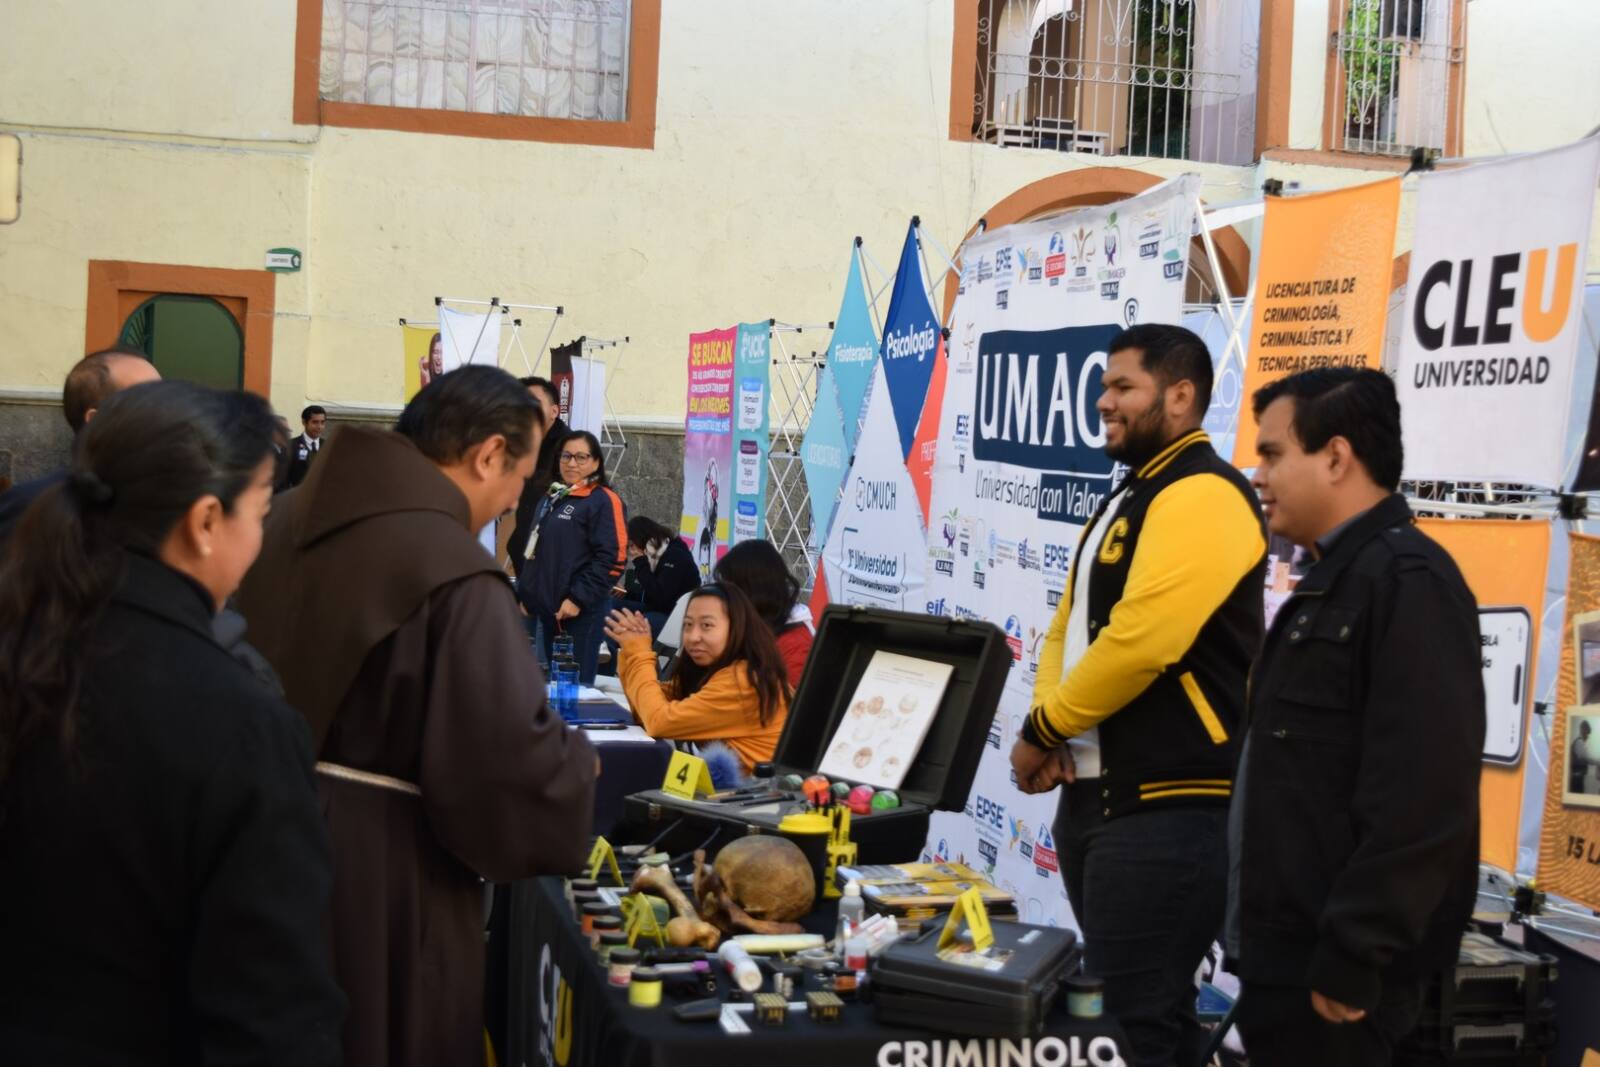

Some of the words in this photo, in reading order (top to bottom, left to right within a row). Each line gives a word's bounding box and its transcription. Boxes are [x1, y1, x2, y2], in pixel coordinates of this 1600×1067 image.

[1266, 280, 1338, 298] LICENCIATURA
[1340, 277, 1356, 293] DE
[1413, 243, 1578, 351] CLEU
[1263, 300, 1341, 322] CRIMINOLOGÍA,
[886, 321, 935, 362] Psicología
[1260, 326, 1342, 347] CRIMINALÍSTICA
[1346, 328, 1354, 344] Y
[692, 342, 702, 366] SE
[702, 339, 733, 366] BUSCAN
[835, 341, 873, 367] Fisioterapia
[1258, 355, 1306, 372] TECNICAS
[1414, 356, 1550, 389] UNIVERSIDAD
[978, 350, 1108, 448] UMAC
[866, 481, 897, 510] CMUCH
[976, 469, 1039, 510] Universidad
[1041, 486, 1063, 513] con
[855, 550, 897, 577] Universidad
[1044, 543, 1069, 572] EPSE
[926, 598, 946, 617] eif
[1480, 633, 1499, 646] BLA
[676, 763, 691, 785] 4
[976, 795, 1004, 829] EPSE
[1567, 835, 1585, 860] 15
[877, 1036, 1127, 1067] CRIMINOLO
